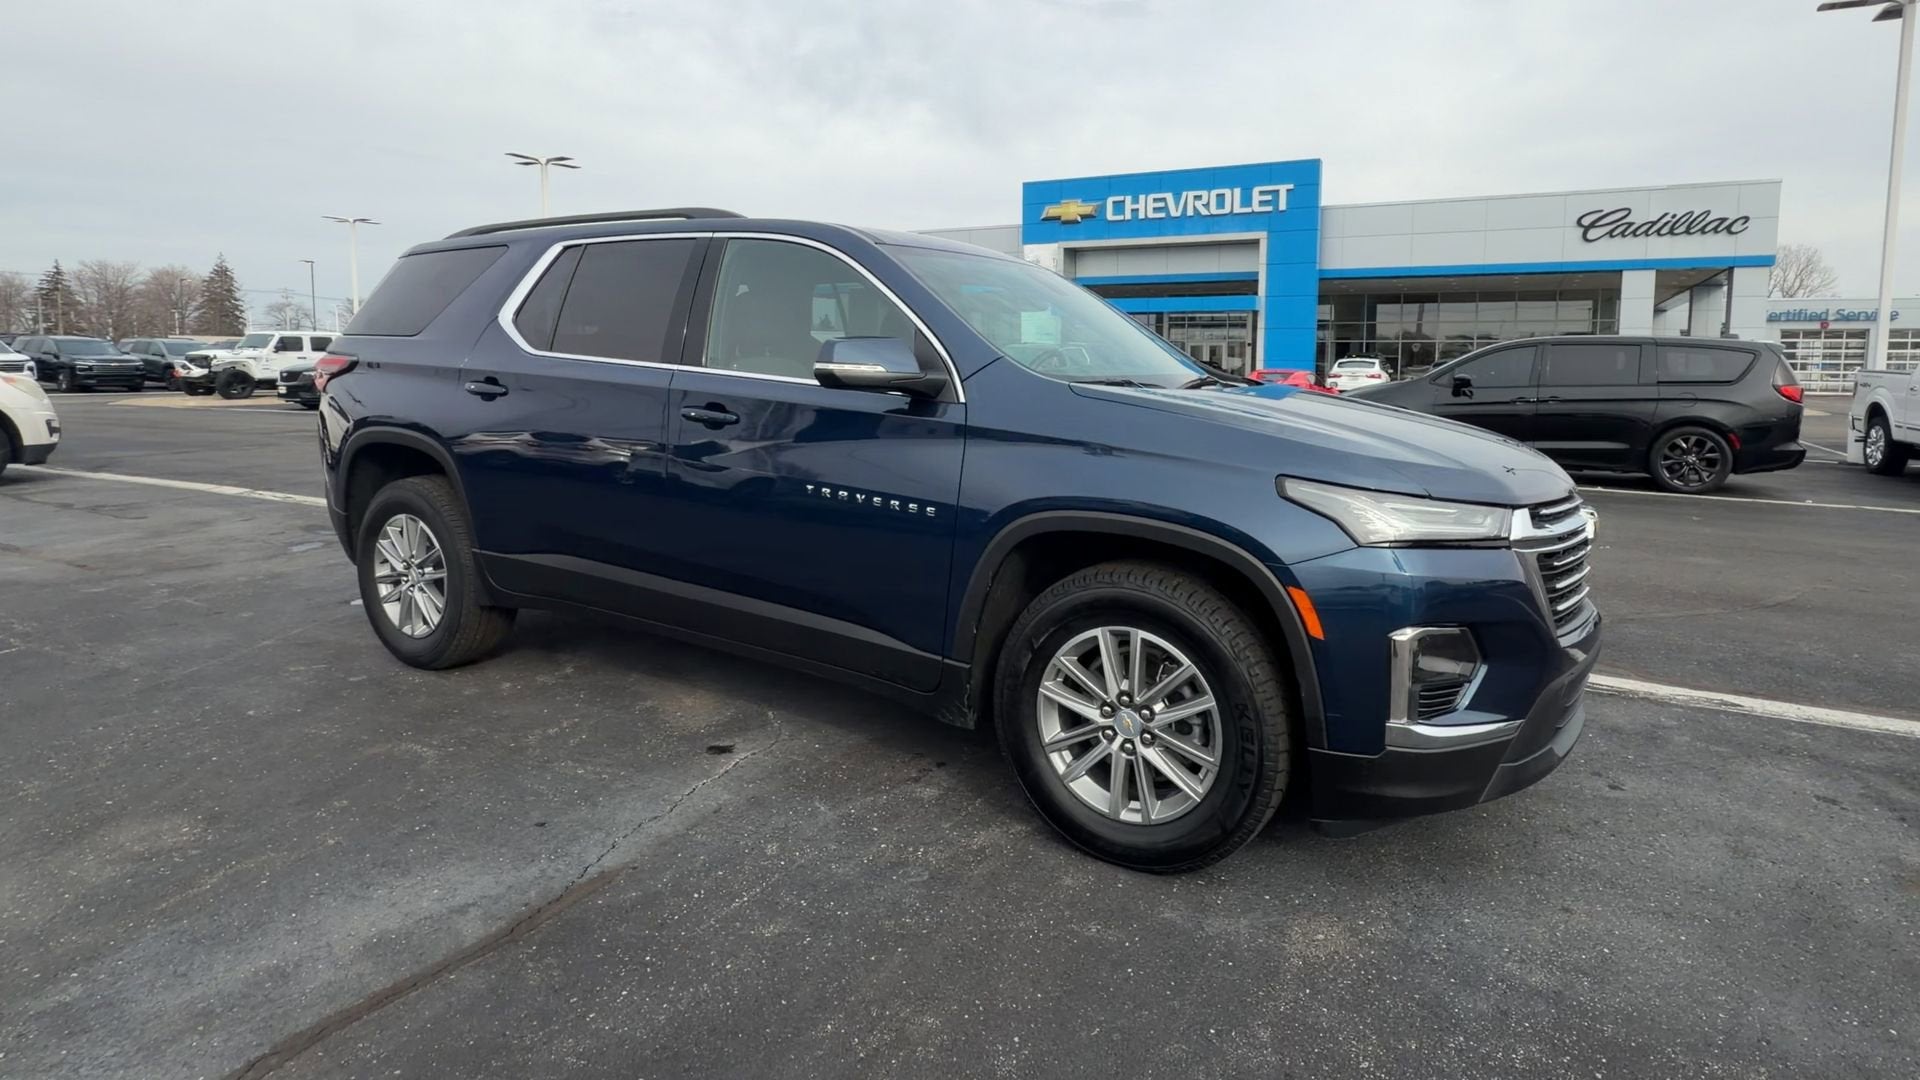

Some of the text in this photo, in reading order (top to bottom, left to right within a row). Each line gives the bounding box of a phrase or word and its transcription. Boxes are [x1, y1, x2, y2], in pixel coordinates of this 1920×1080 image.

[1106, 184, 1294, 221] CHEVROLET
[1576, 208, 1750, 242] Cadillac
[1766, 307, 1900, 321] ertified Servie
[806, 484, 936, 517] TRAVERSE
